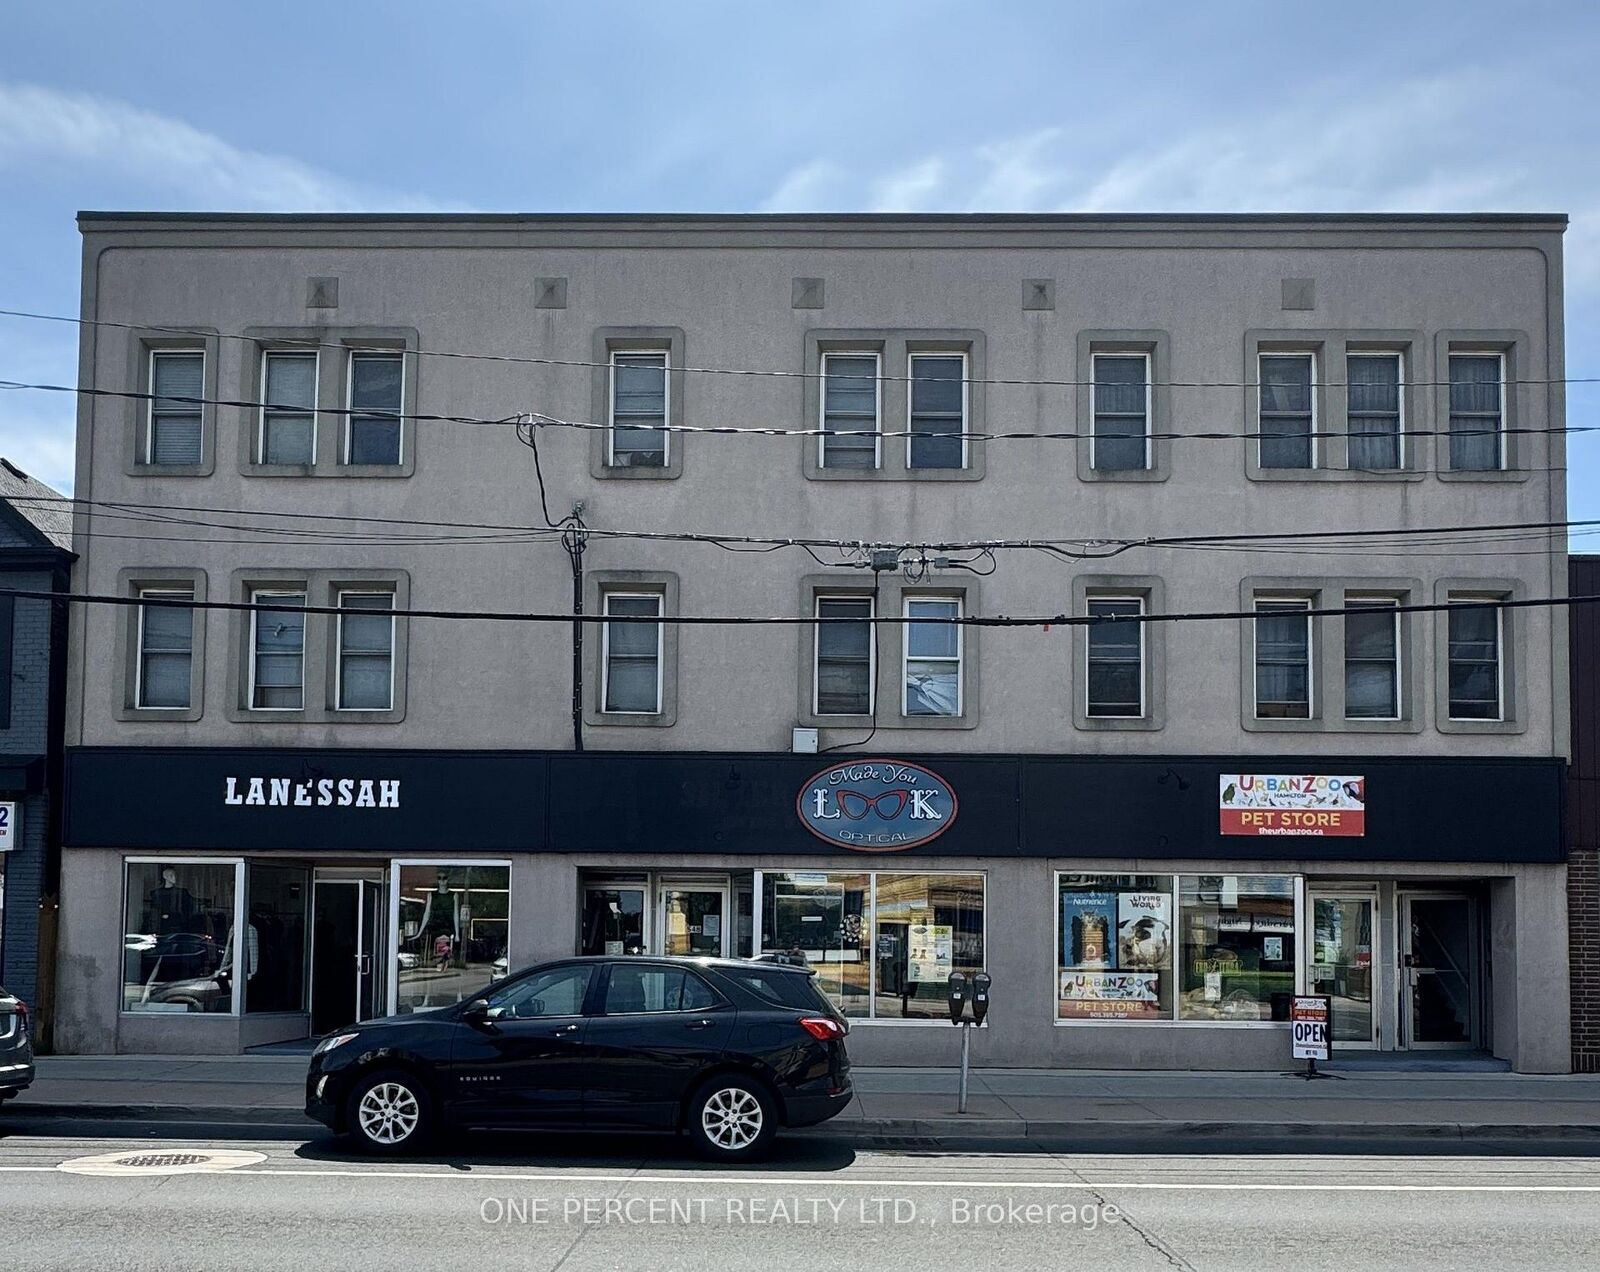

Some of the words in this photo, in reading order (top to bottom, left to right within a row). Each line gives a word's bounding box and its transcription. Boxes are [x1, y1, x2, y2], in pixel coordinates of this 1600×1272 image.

[829, 765, 880, 785] Made
[882, 764, 918, 785] You
[225, 777, 400, 808] LANESSAH
[1241, 812, 1275, 826] PET
[1281, 812, 1341, 827] STORE
[839, 829, 914, 844] OPTICAL
[1076, 1001, 1099, 1012] PET
[1102, 1001, 1142, 1012] STORE
[1294, 1023, 1328, 1042] OPEN
